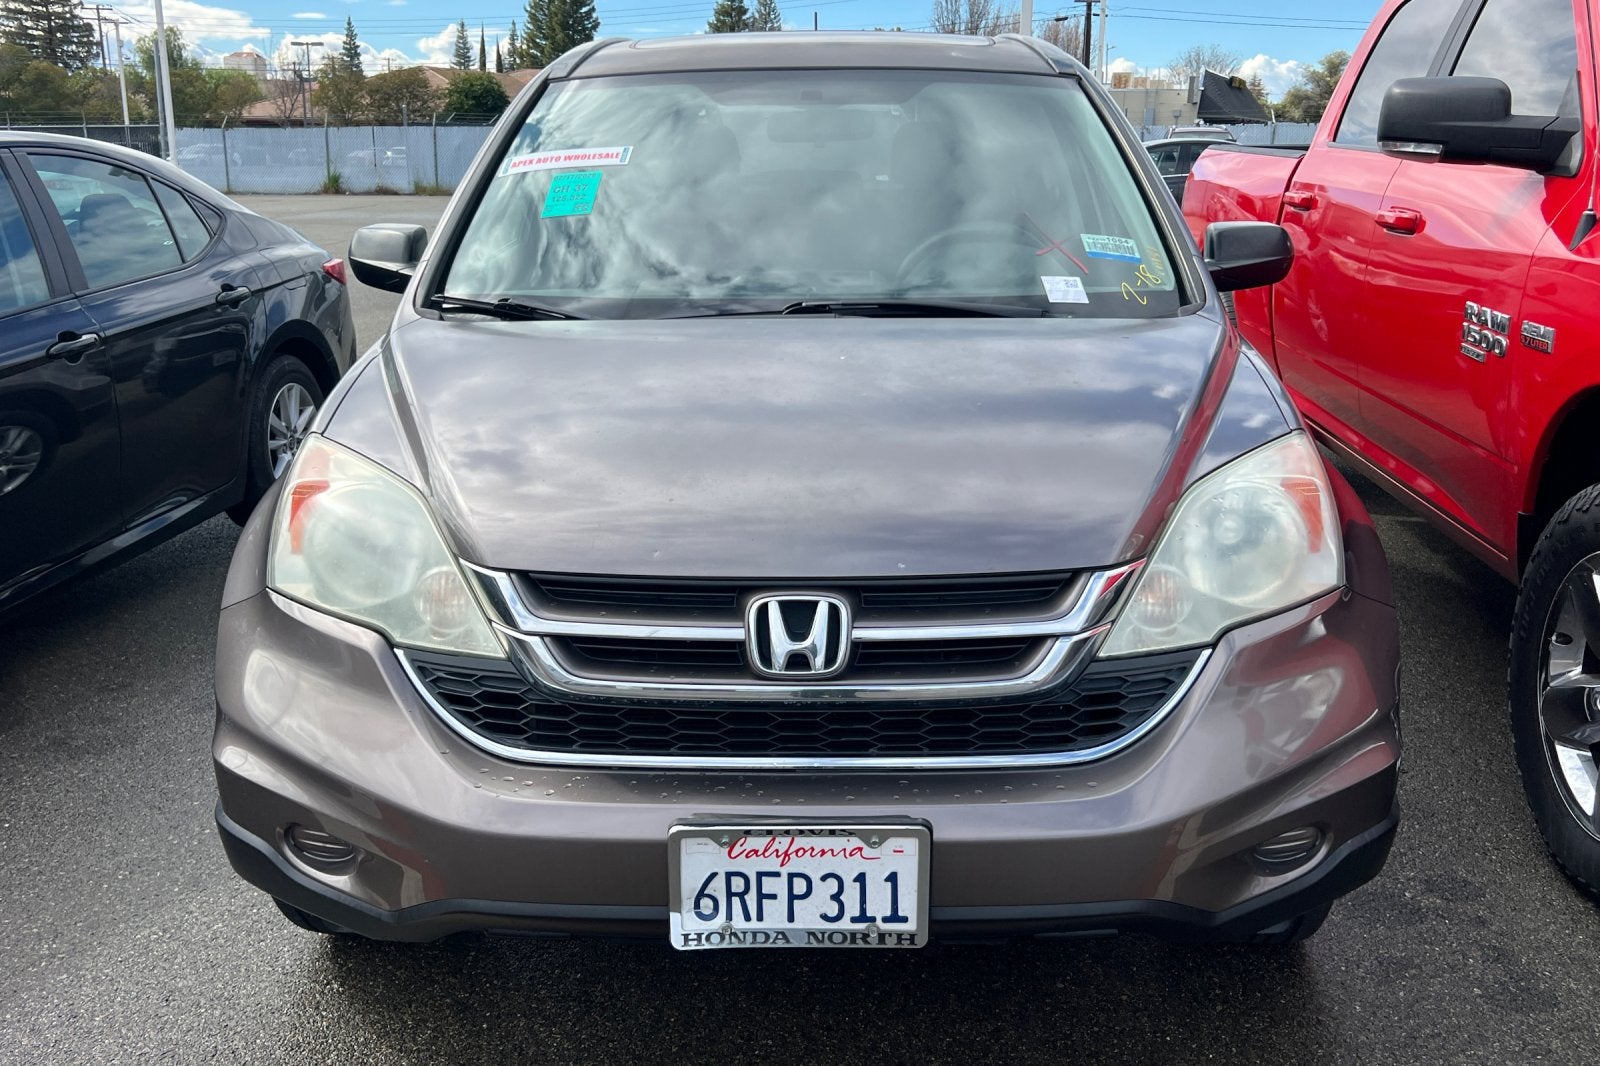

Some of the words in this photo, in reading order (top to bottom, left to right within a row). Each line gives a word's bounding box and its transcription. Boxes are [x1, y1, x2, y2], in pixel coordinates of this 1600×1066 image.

[512, 158, 534, 168] APEX
[536, 156, 561, 164] AUTO
[564, 152, 620, 161] WHOLESALE
[1465, 301, 1510, 335] RAM
[1462, 322, 1509, 357] 1500
[727, 836, 881, 867] California
[693, 871, 909, 923] 6RFP311
[681, 931, 794, 948] HONDA
[804, 930, 918, 946] NORTH
